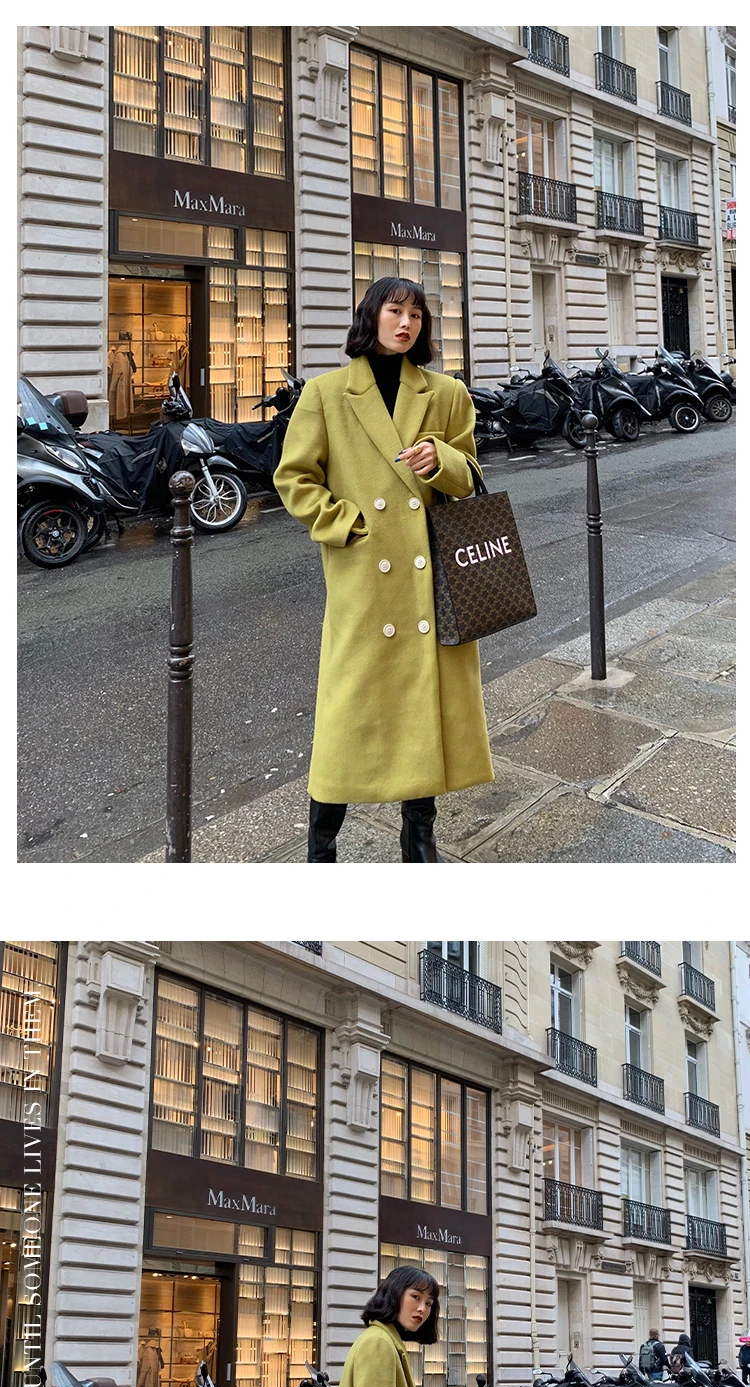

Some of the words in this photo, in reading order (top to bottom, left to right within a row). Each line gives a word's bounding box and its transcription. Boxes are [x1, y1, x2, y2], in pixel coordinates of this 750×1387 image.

[173, 189, 246, 217] MaxMara
[390, 221, 436, 242] MaxMara
[455, 536, 512, 567] CELINE
[207, 1188, 277, 1216] MaxMara
[416, 1224, 462, 1245] MaxMara
